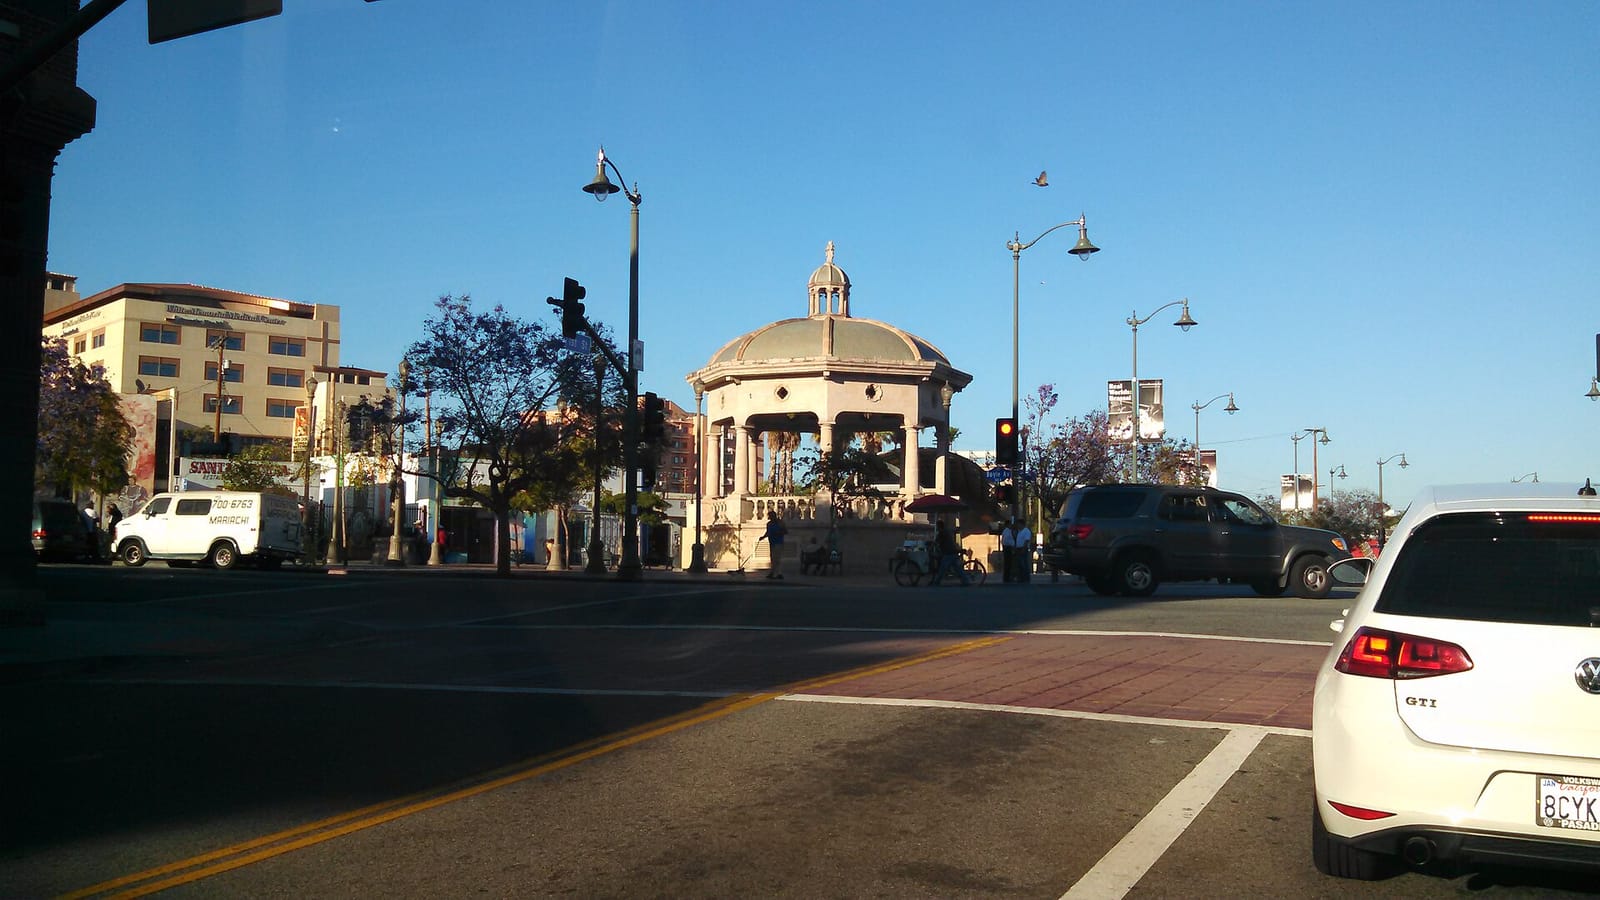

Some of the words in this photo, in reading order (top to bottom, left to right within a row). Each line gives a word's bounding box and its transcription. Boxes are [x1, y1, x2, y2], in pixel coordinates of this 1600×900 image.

[209, 516, 249, 524] MARIACHI
[1405, 696, 1437, 708] GTI
[1545, 795, 1598, 823] 8CYK
